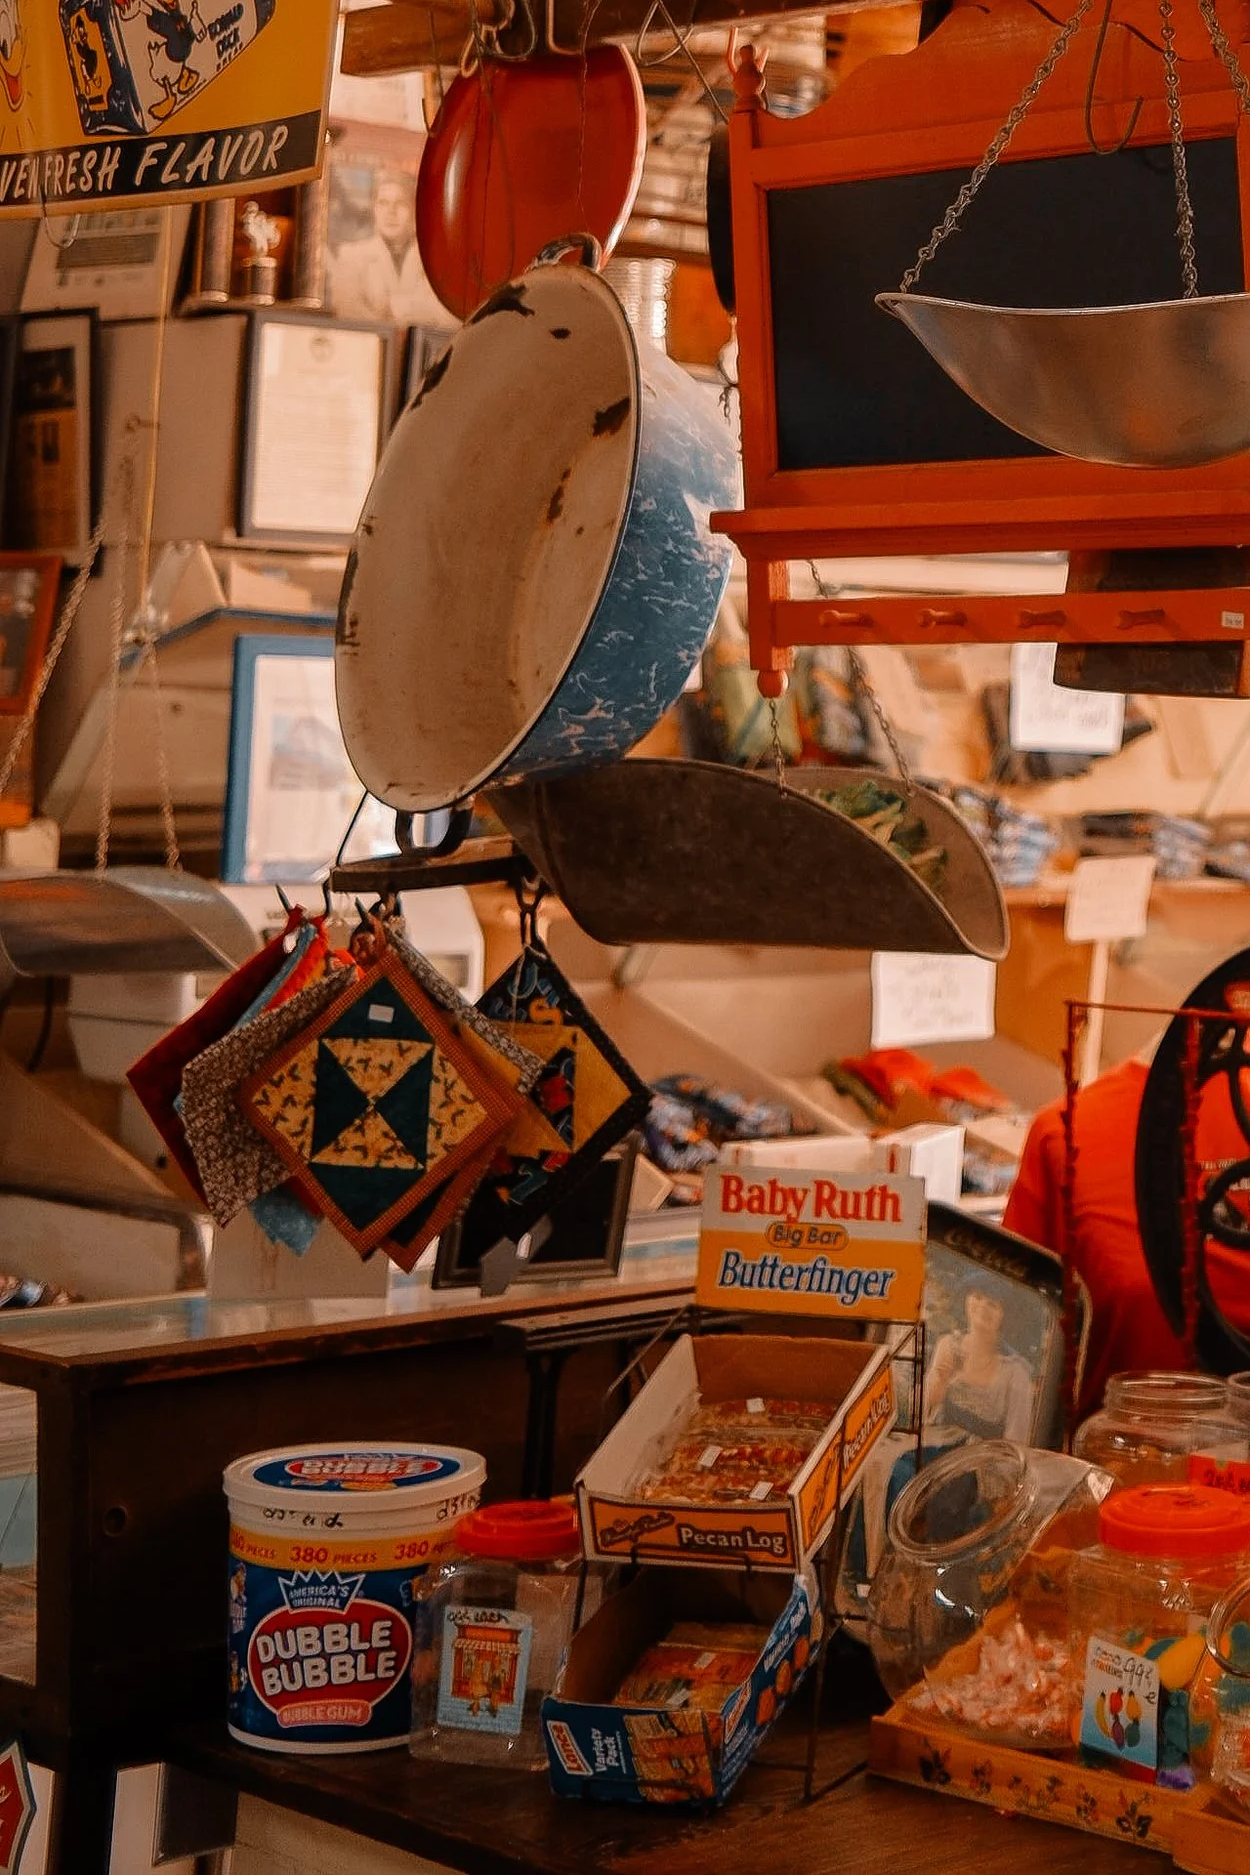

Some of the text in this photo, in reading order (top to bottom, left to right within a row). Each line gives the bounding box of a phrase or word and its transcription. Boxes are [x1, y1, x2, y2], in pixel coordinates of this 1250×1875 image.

[45, 143, 119, 196] FRESH
[135, 125, 289, 188] FLAVOR
[720, 1174, 902, 1224] Baby Ruth
[773, 1224, 842, 1249] Big Bar
[717, 1249, 896, 1309] Butterfinger
[289, 1546, 329, 1563] 380
[332, 1553, 377, 1565] PIECES
[393, 1540, 429, 1562] 380
[680, 1525, 745, 1548] Pecan
[748, 1527, 785, 1555] Log
[256, 1619, 393, 1664] DUBBLE
[261, 1649, 398, 1698] BUBBLE
[327, 1704, 362, 1720] GUM
[591, 1726, 608, 1773] Variety
[605, 1734, 620, 1767] Pack
